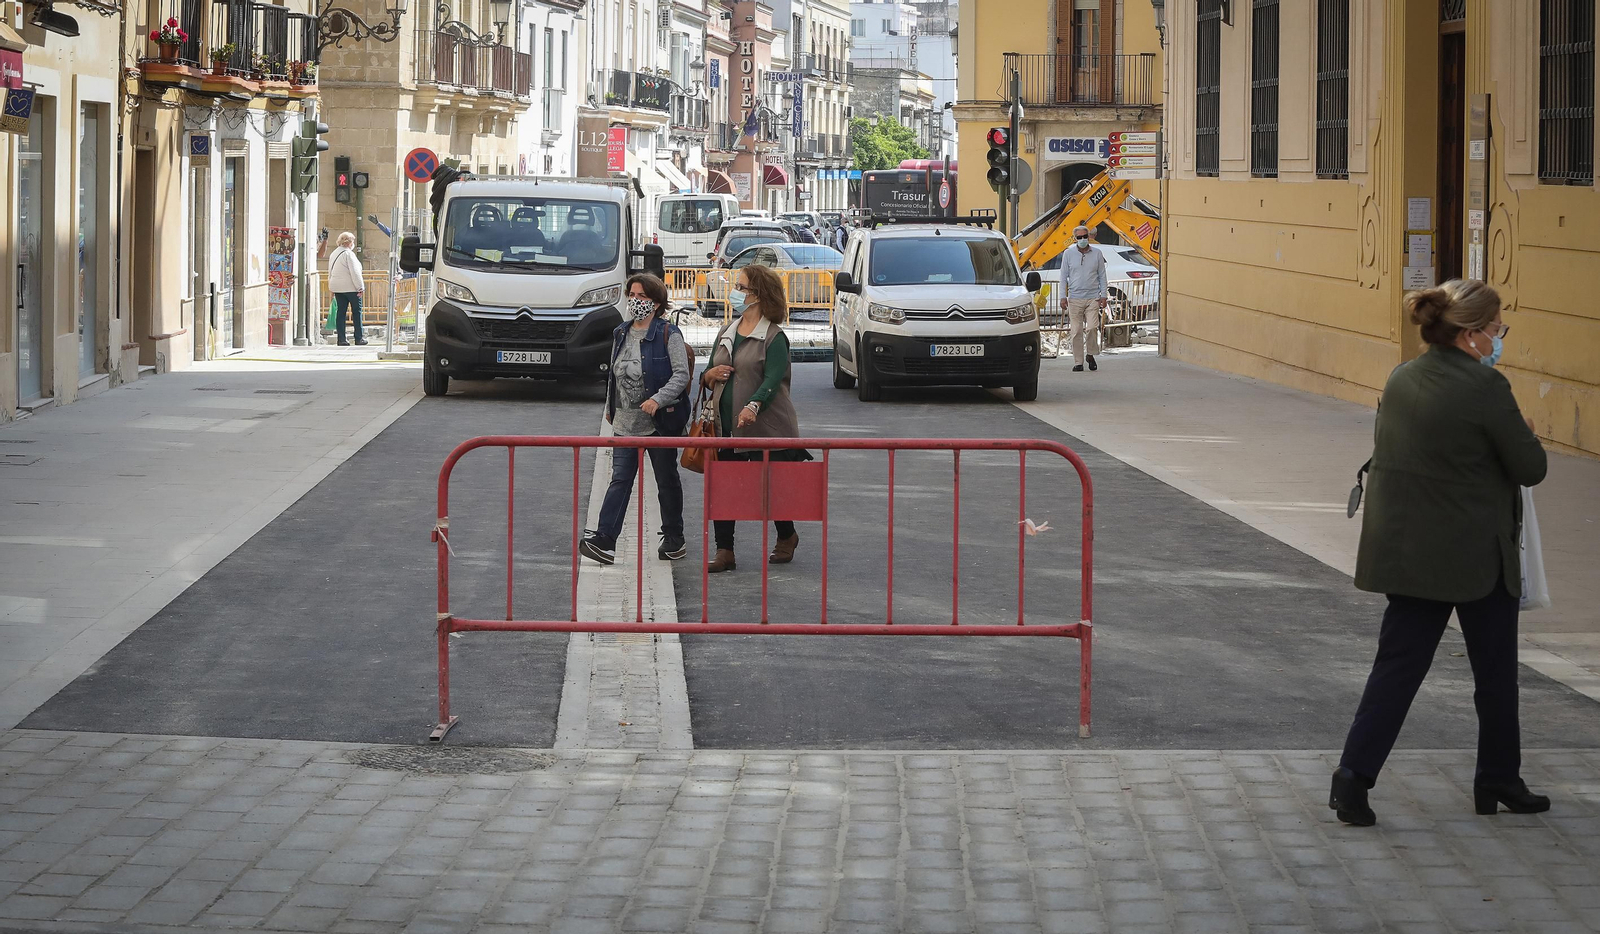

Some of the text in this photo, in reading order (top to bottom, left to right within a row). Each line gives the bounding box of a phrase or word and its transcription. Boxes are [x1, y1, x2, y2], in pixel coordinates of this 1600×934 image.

[770, 72, 802, 81] HOTEL
[579, 130, 607, 147] L12
[1049, 138, 1095, 153] asisa
[765, 155, 783, 164] HOTEL
[891, 190, 926, 201] Trasur
[880, 201, 912, 209] Concesionario
[936, 345, 982, 355] 7823 LCP
[503, 352, 548, 363] 5728 LJX
